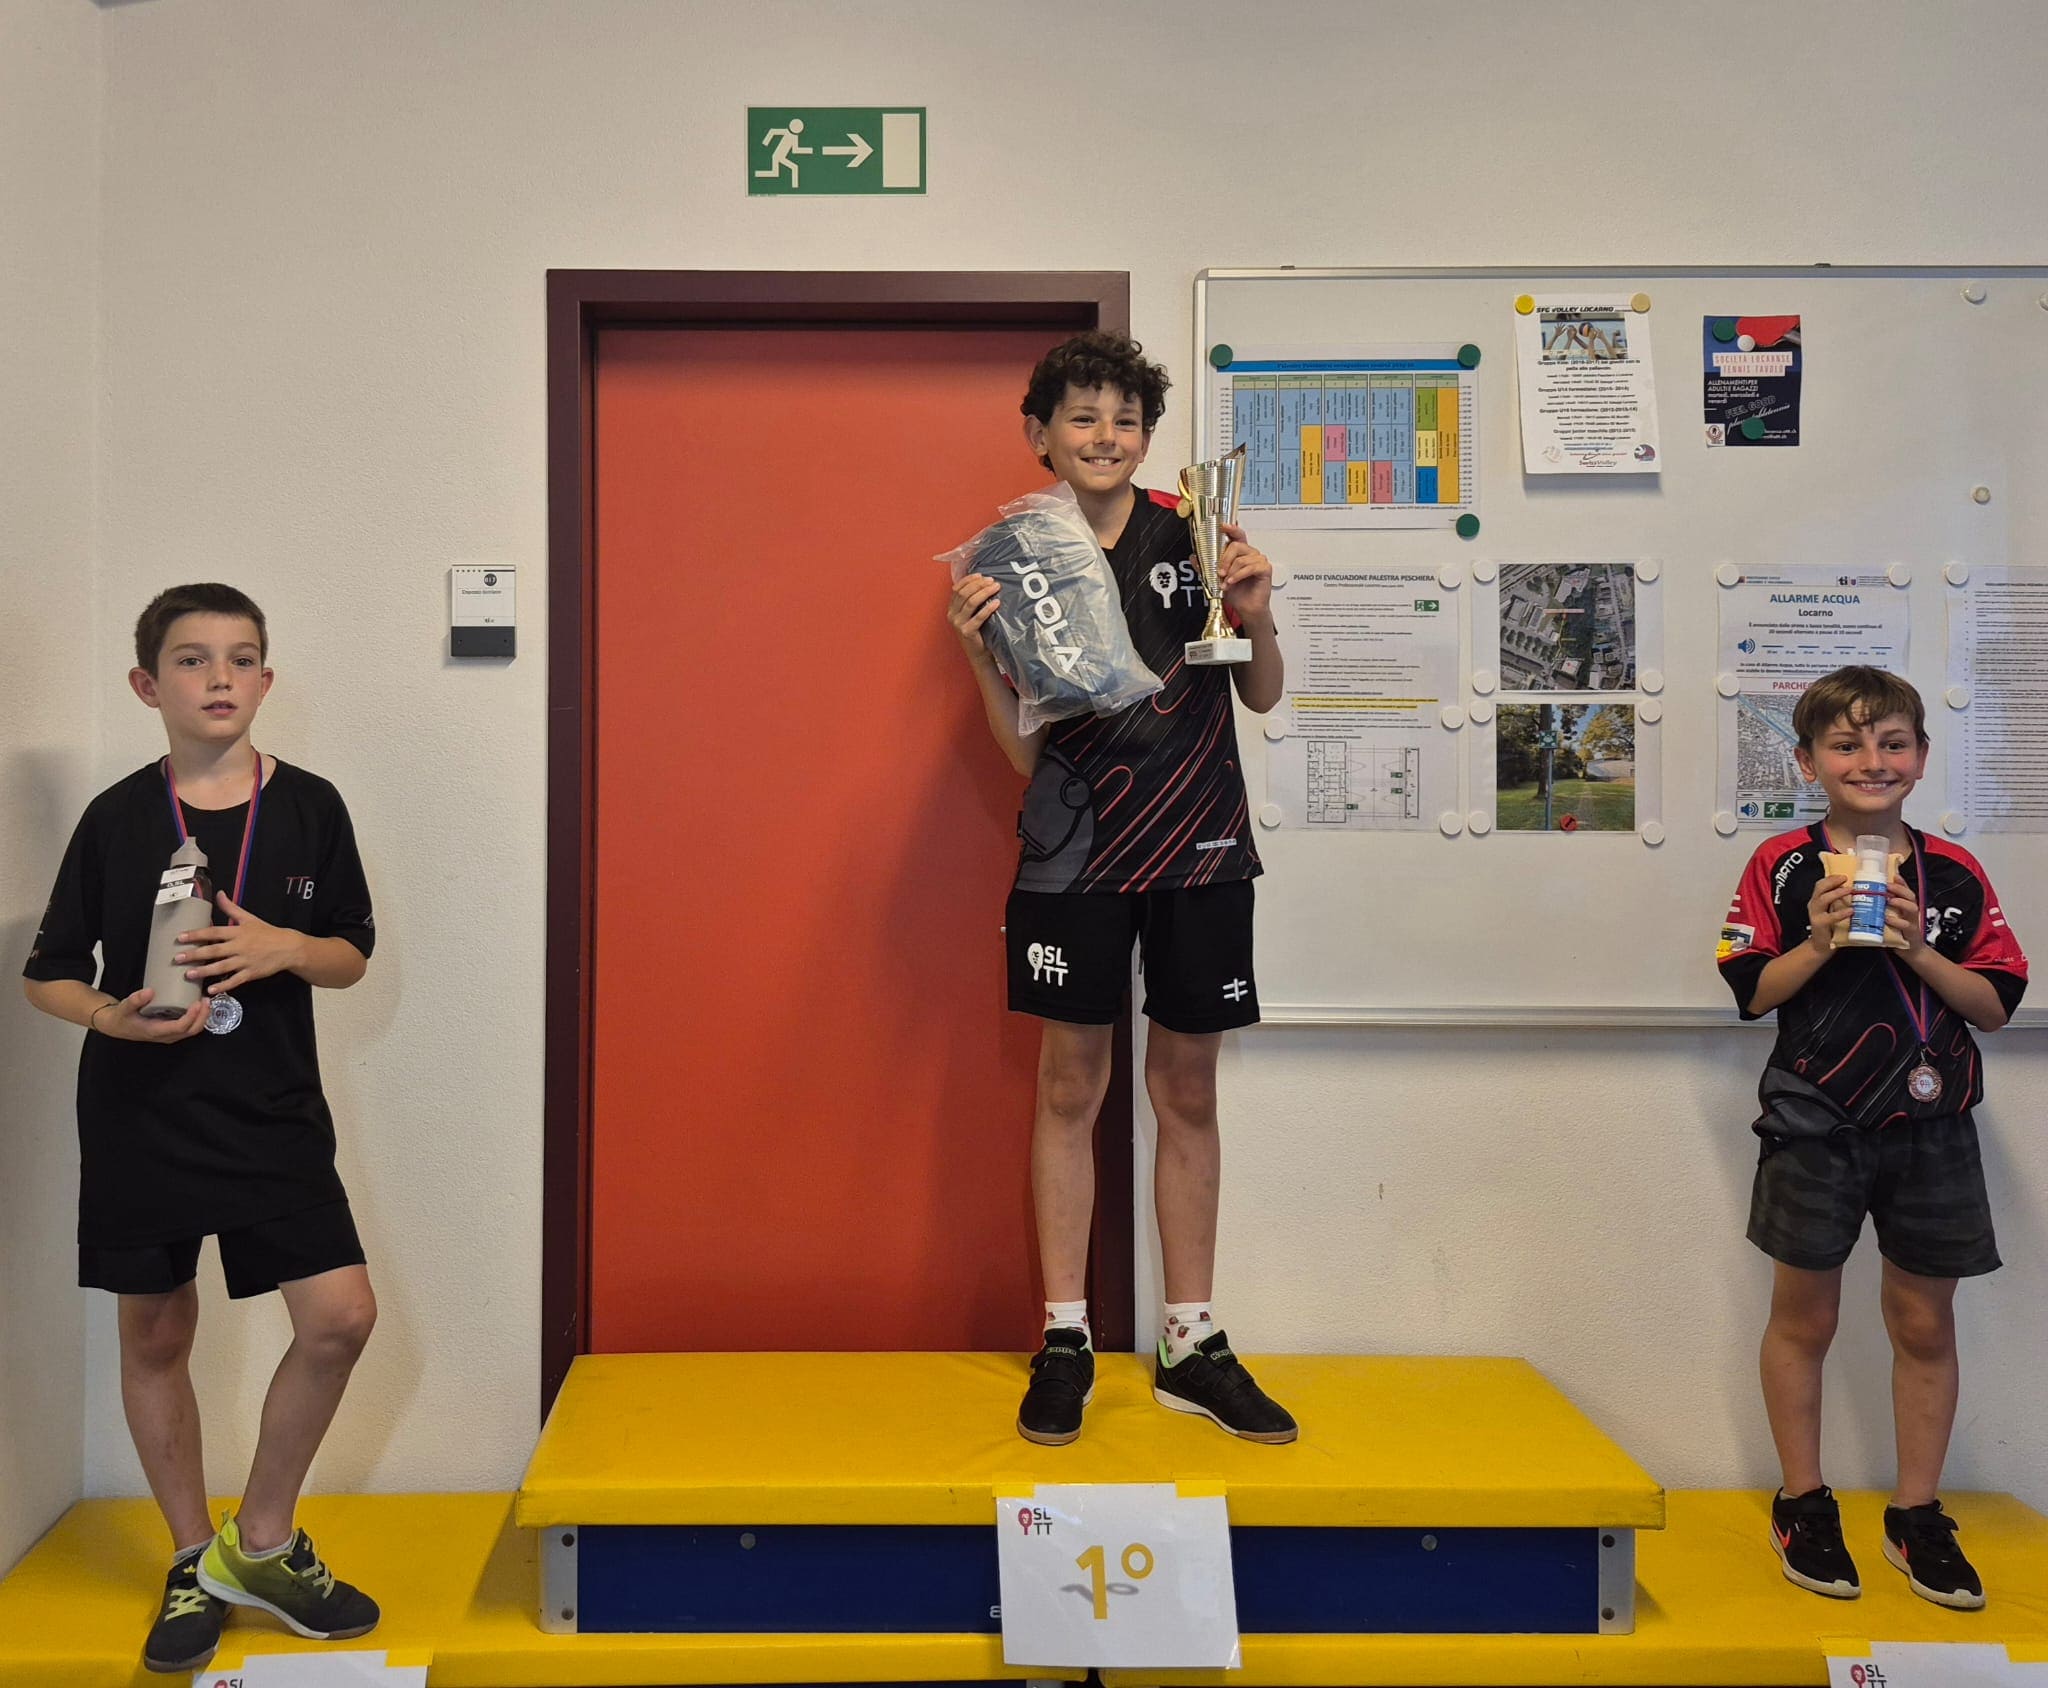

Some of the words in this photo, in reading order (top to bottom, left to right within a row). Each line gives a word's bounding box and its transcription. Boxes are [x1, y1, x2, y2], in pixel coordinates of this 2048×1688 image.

[1178, 560, 1202, 582] S
[1838, 576, 1848, 586] ti
[1770, 594, 1819, 604] ALLARME
[1821, 594, 1861, 605] ACQUA
[1010, 561, 1083, 674] JOOLA
[1798, 608, 1834, 617] Locarno
[286, 876, 315, 900] TTB
[1044, 945, 1068, 967] SL
[1043, 965, 1069, 987] TT
[1034, 1508, 1051, 1520] SL
[1034, 1522, 1053, 1535] TT
[1865, 1664, 1885, 1678] SL
